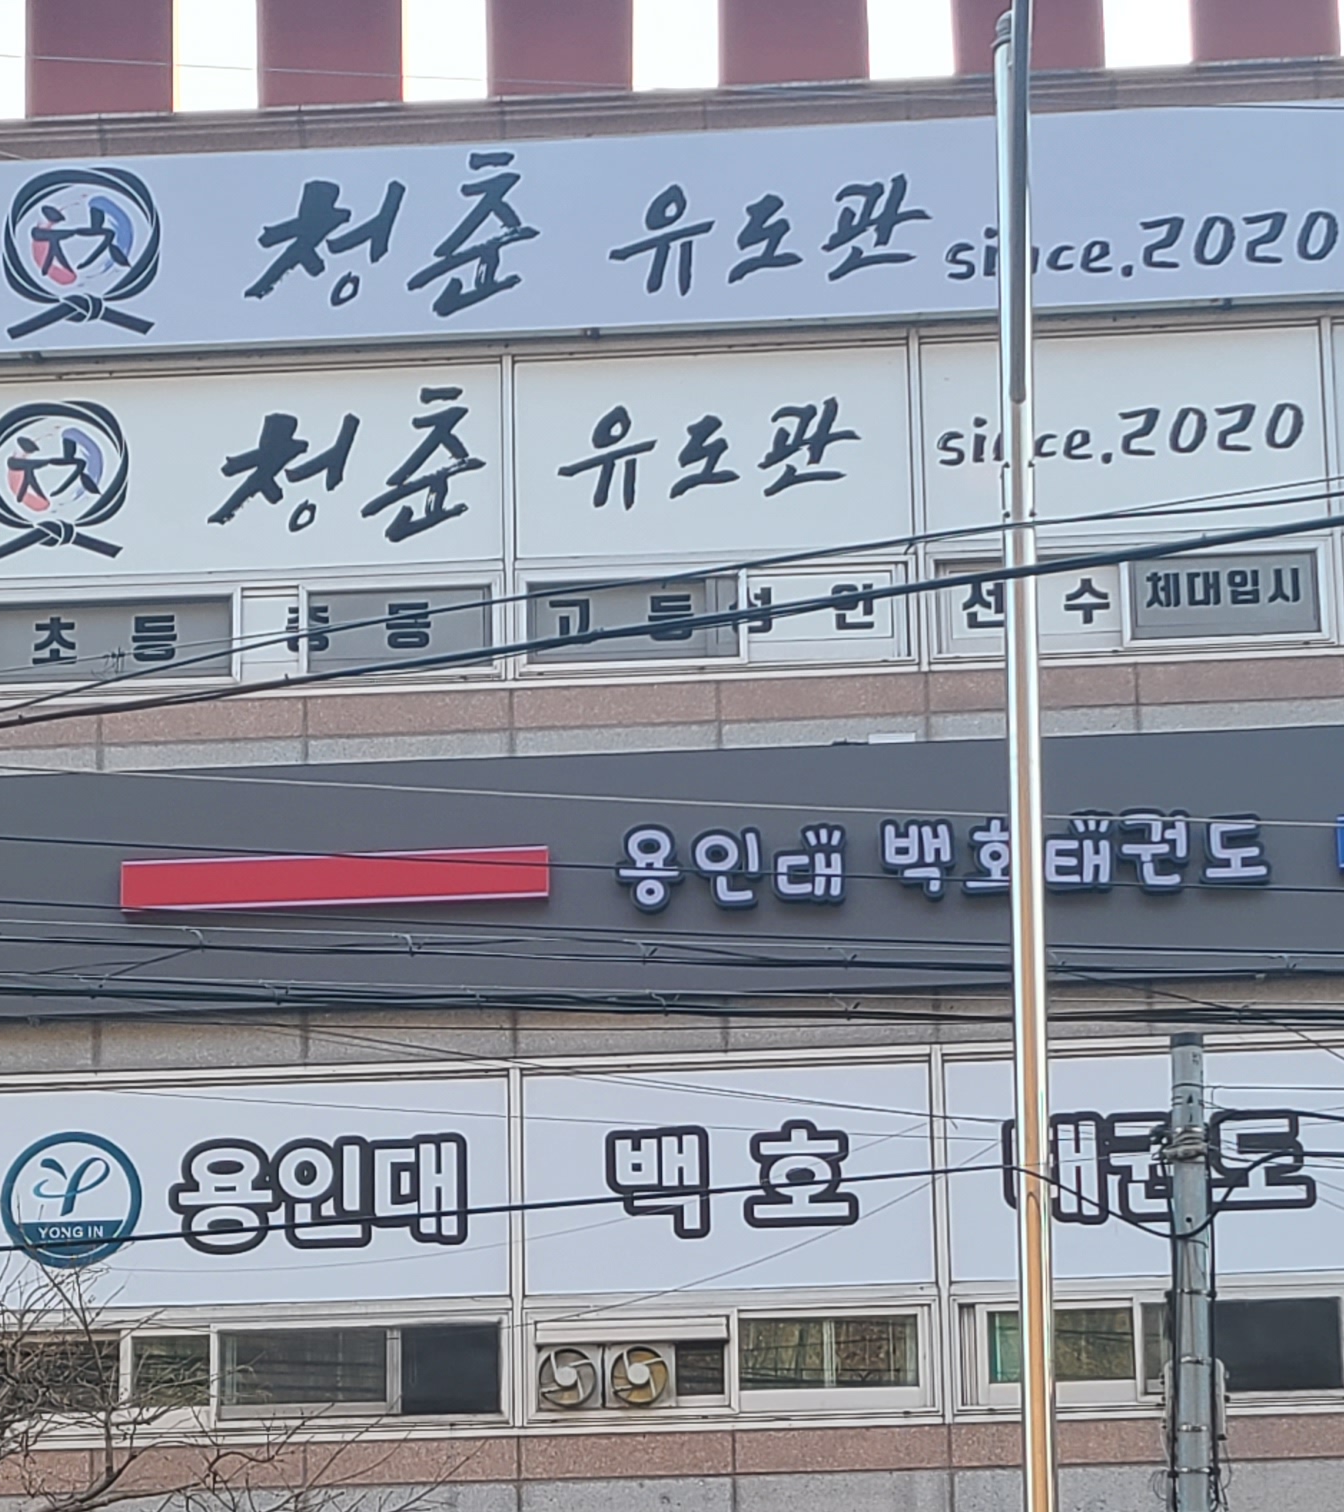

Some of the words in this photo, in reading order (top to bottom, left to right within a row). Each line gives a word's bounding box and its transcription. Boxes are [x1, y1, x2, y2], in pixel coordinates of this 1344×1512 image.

[244, 152, 540, 316] 청춘
[609, 173, 933, 295] 유도관
[946, 209, 1339, 280] sice.2020
[209, 389, 487, 543] 청춘
[558, 398, 860, 511] 유도관
[937, 401, 1305, 467] sice.2020
[1146, 568, 1301, 610] 체대입시
[615, 822, 849, 911] 용인대
[38, 1227, 83, 1238] YONG
[88, 1226, 103, 1238] IN
[169, 1132, 467, 1255] 용인대
